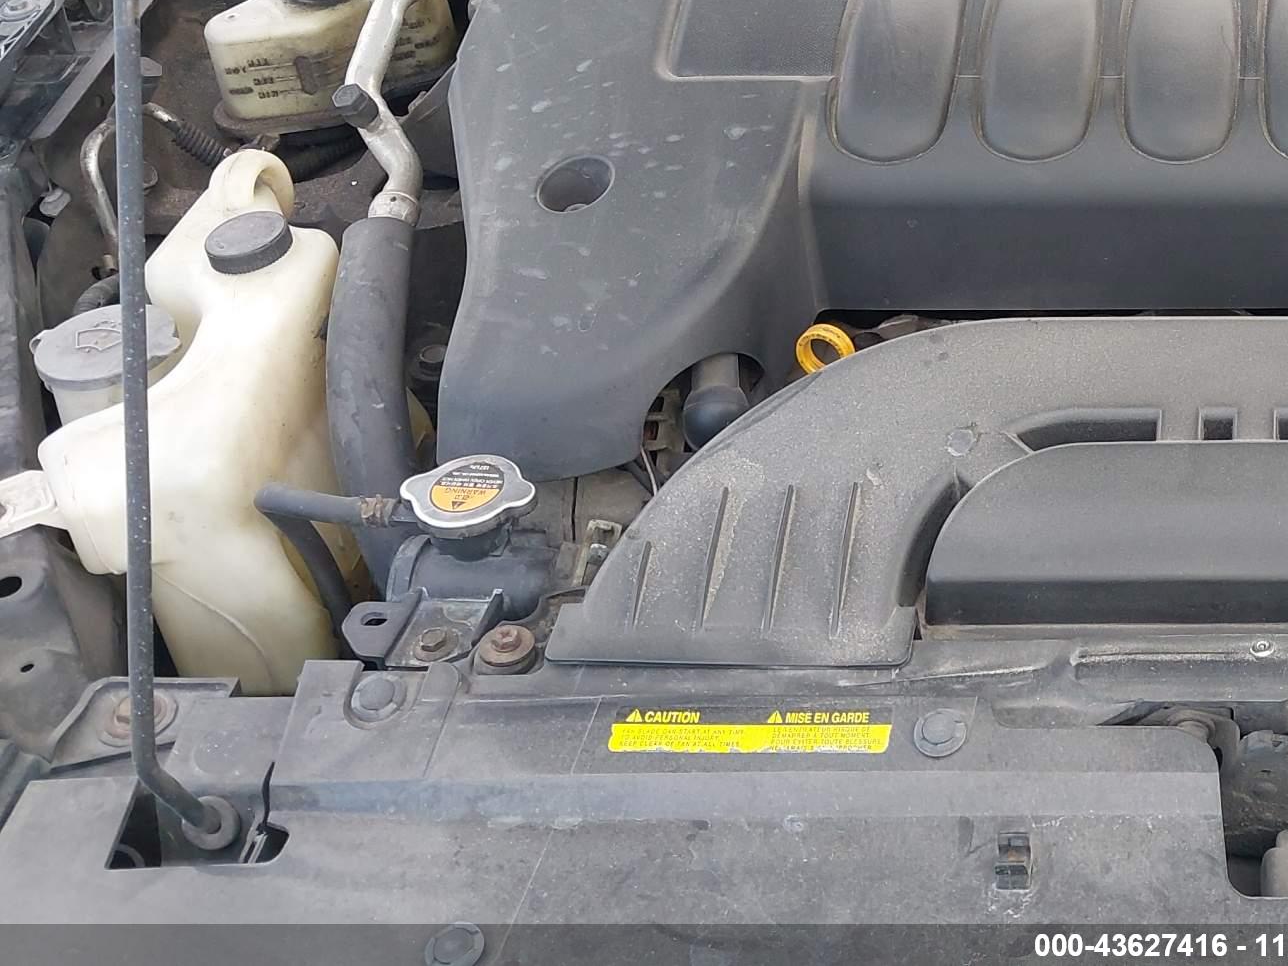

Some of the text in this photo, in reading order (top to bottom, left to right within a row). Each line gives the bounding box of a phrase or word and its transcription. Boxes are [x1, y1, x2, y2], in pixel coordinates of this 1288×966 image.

[444, 488, 487, 496] WARNING
[644, 711, 701, 724] CAUTION
[785, 712, 870, 724] MISE EN GARDE
